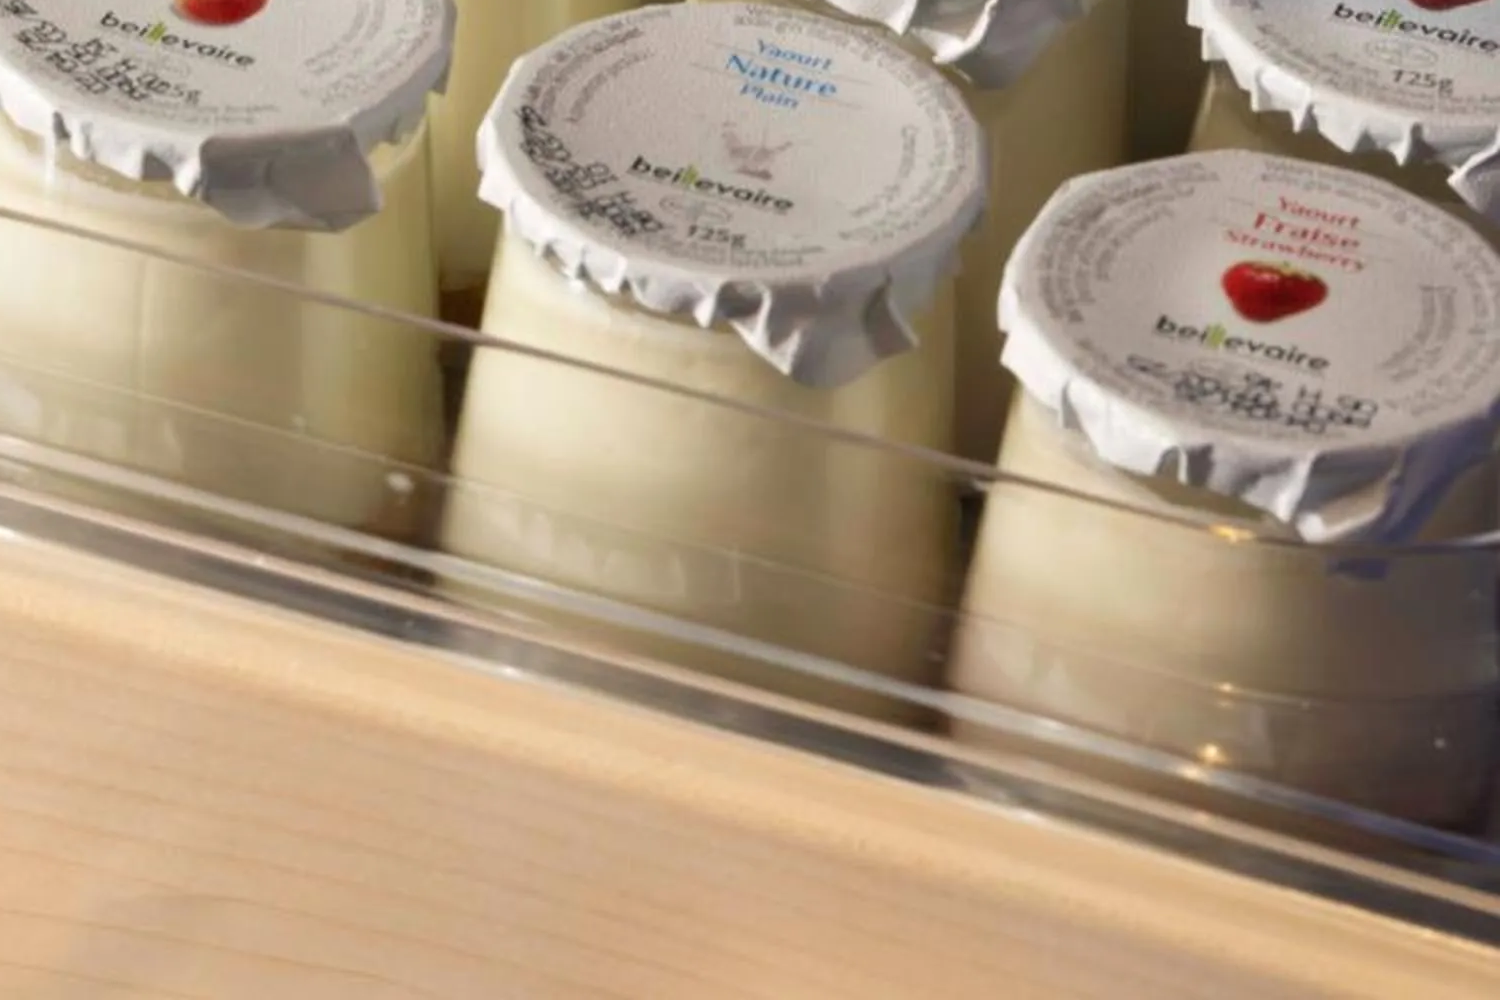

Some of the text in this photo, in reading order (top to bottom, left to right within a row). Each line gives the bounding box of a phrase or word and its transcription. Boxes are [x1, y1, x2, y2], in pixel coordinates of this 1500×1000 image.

[99, 10, 257, 68] beillevaire
[1334, 2, 1500, 53] beillevaire
[724, 52, 839, 100] Nature
[754, 37, 835, 72] Yaourt
[738, 83, 801, 111] Plain
[1392, 68, 1455, 96] 125g
[630, 153, 795, 215] beillevaire
[1252, 211, 1363, 251] Fraise
[1275, 196, 1362, 230] Yaourt
[686, 223, 748, 249] 125g
[1222, 228, 1367, 275] Strawberry
[1154, 313, 1331, 372] beillevaire
